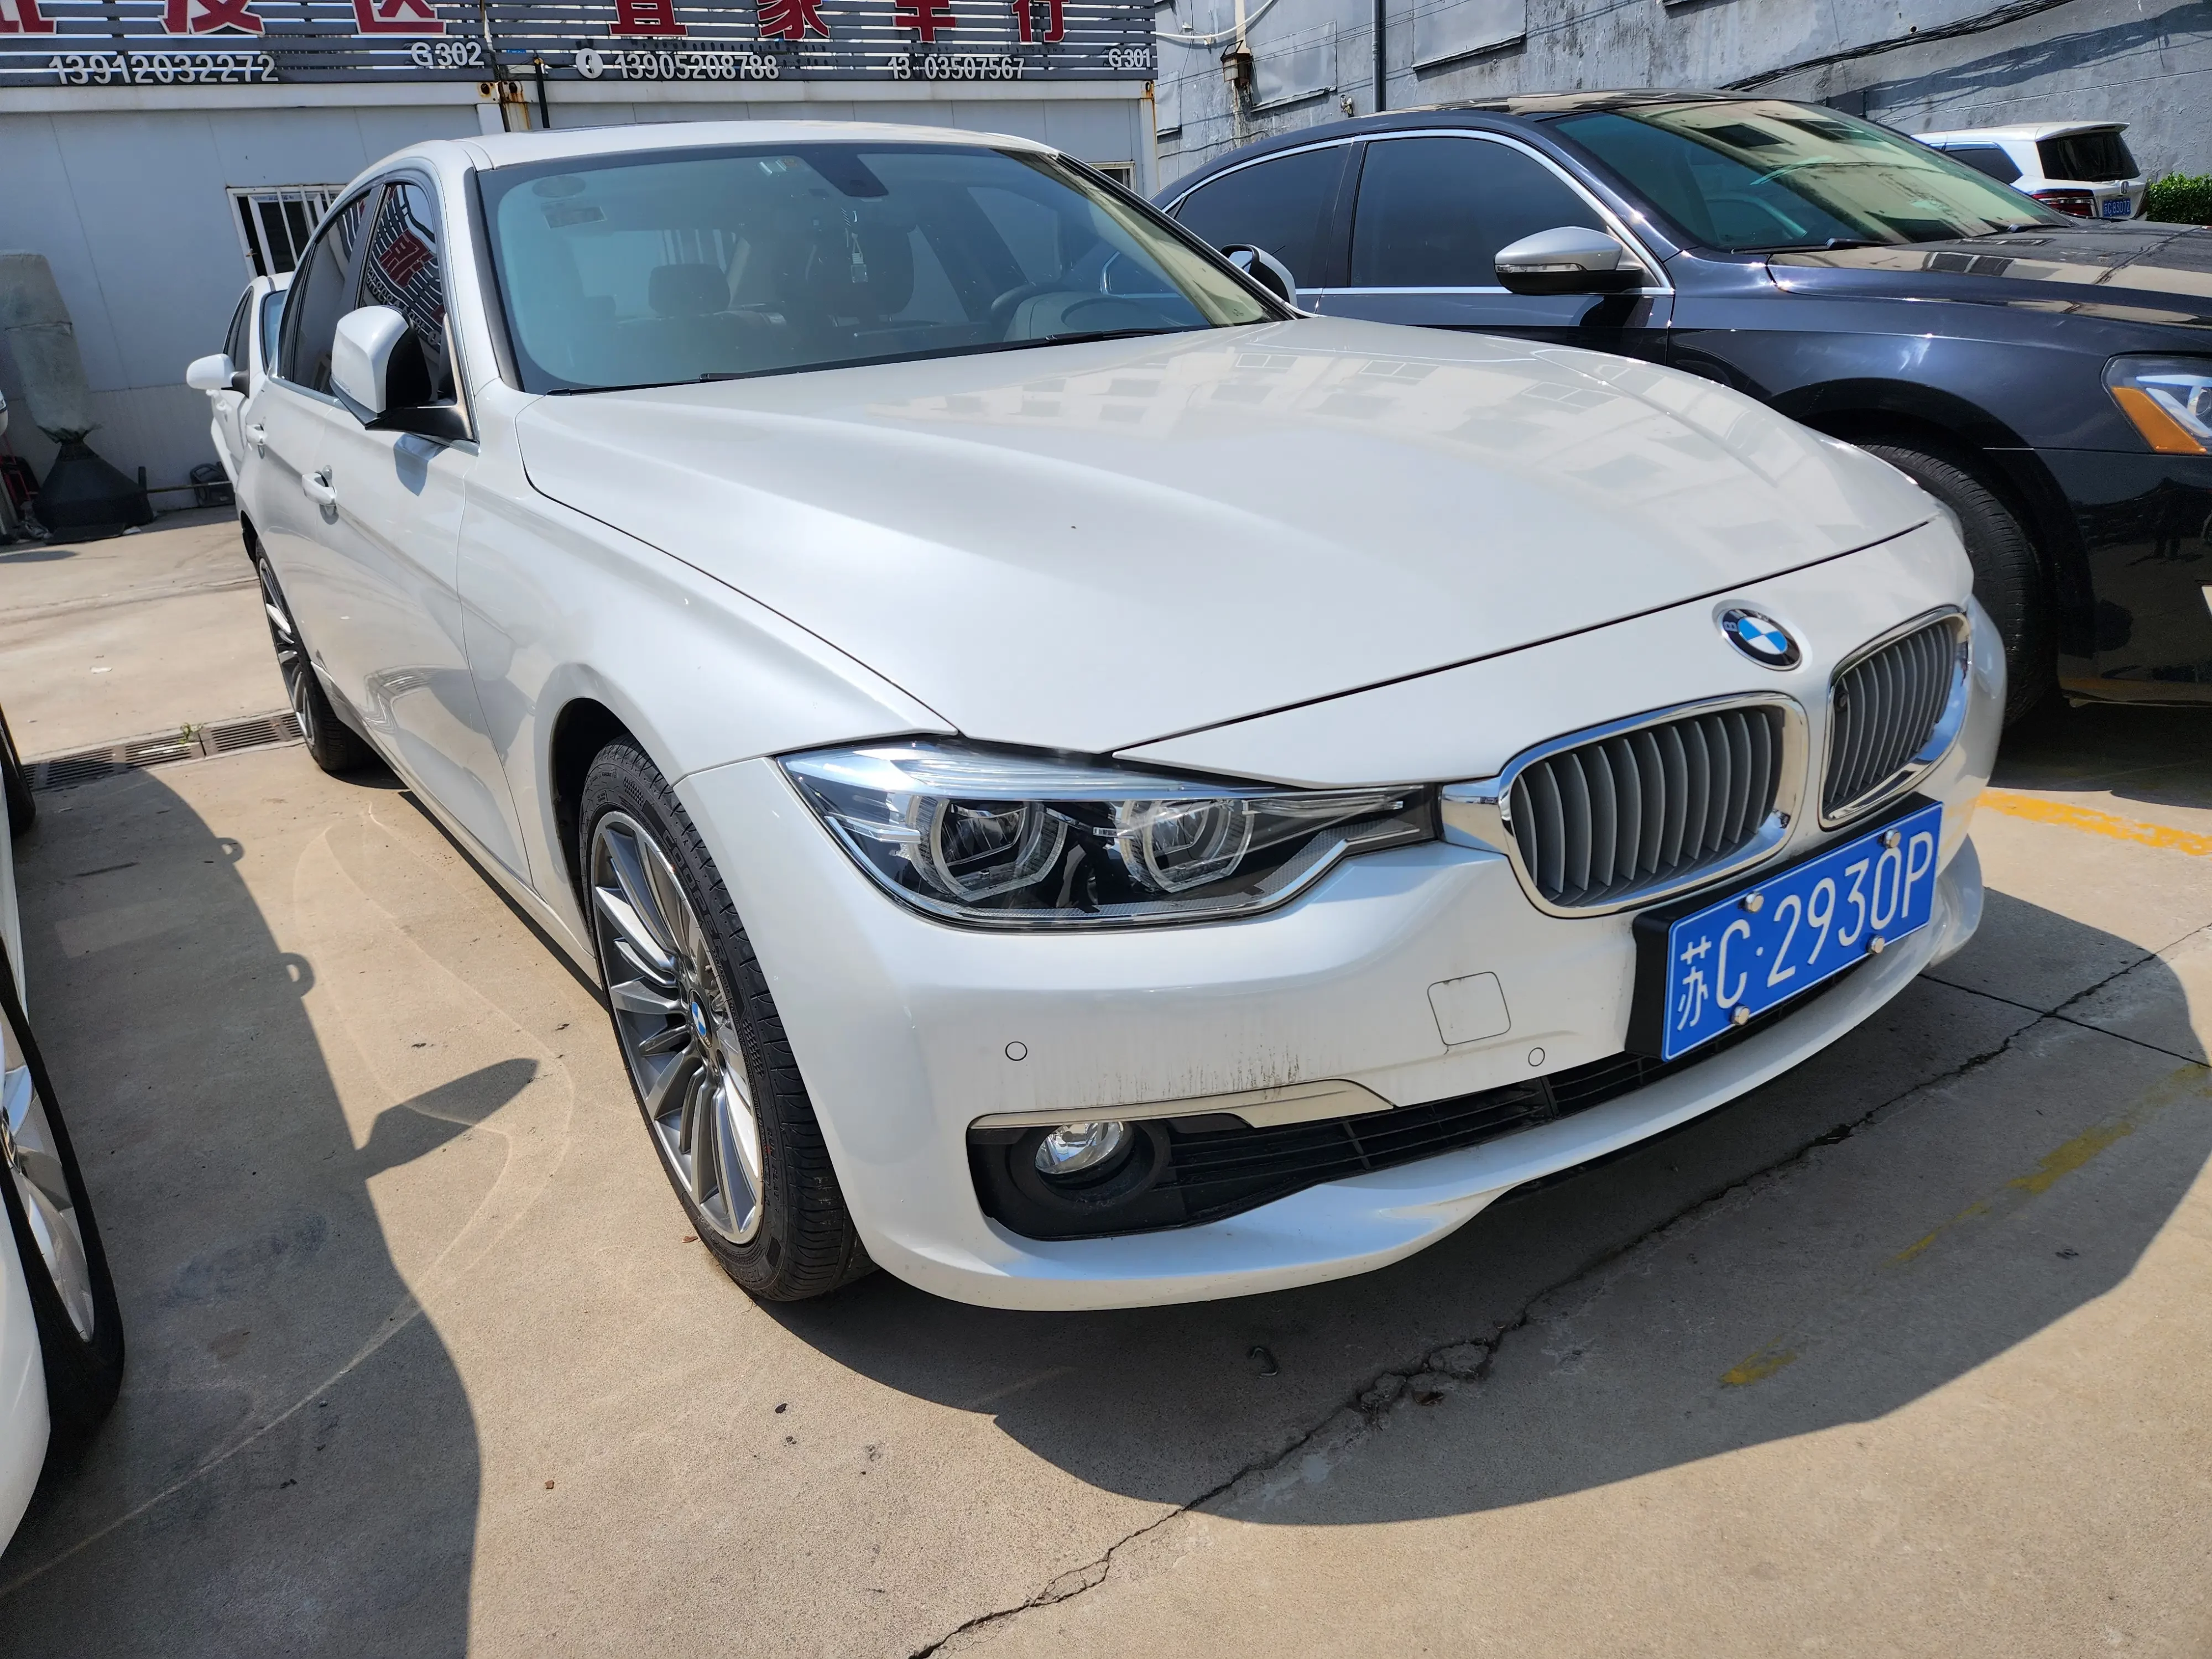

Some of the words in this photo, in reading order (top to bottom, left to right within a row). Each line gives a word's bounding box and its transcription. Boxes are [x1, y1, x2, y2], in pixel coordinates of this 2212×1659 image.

[411, 41, 484, 67] G302
[614, 54, 779, 79] 13905208788
[1108, 48, 1151, 67] G301
[49, 55, 279, 85] 13912032272
